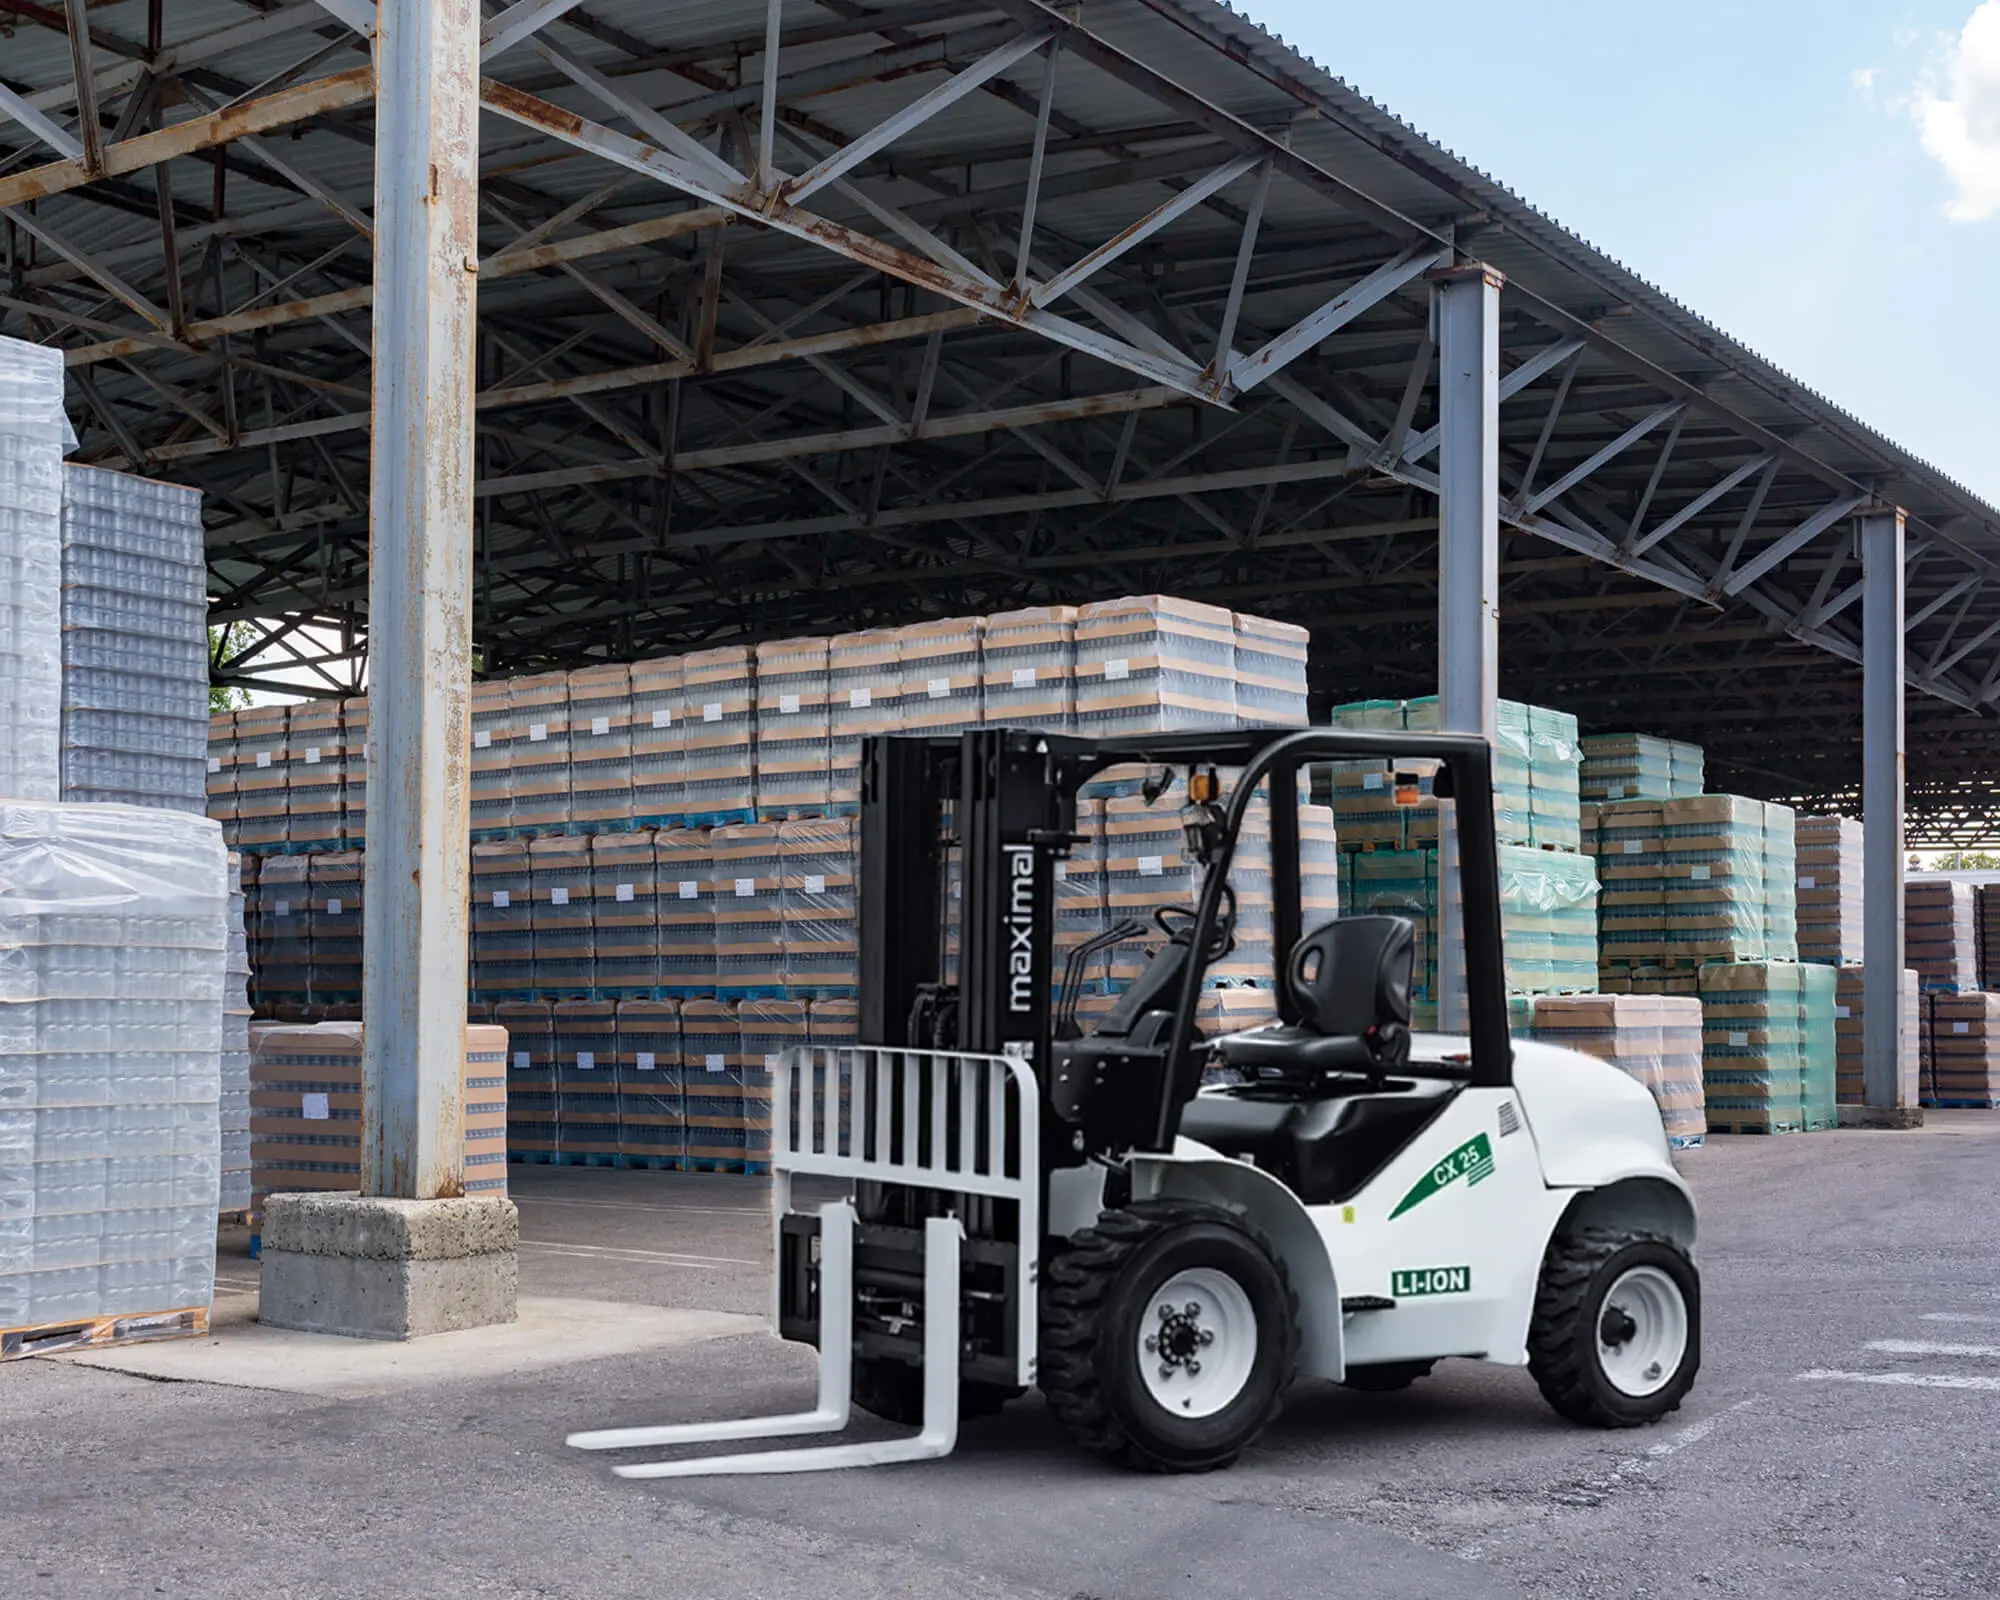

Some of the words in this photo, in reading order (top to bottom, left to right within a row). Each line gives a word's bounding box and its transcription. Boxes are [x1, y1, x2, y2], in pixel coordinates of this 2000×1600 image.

[1002, 844, 1034, 1012] maximal
[1433, 1158, 1459, 1185] CX
[1459, 1145, 1480, 1169] 25
[1397, 1269, 1464, 1293] LI-ION
